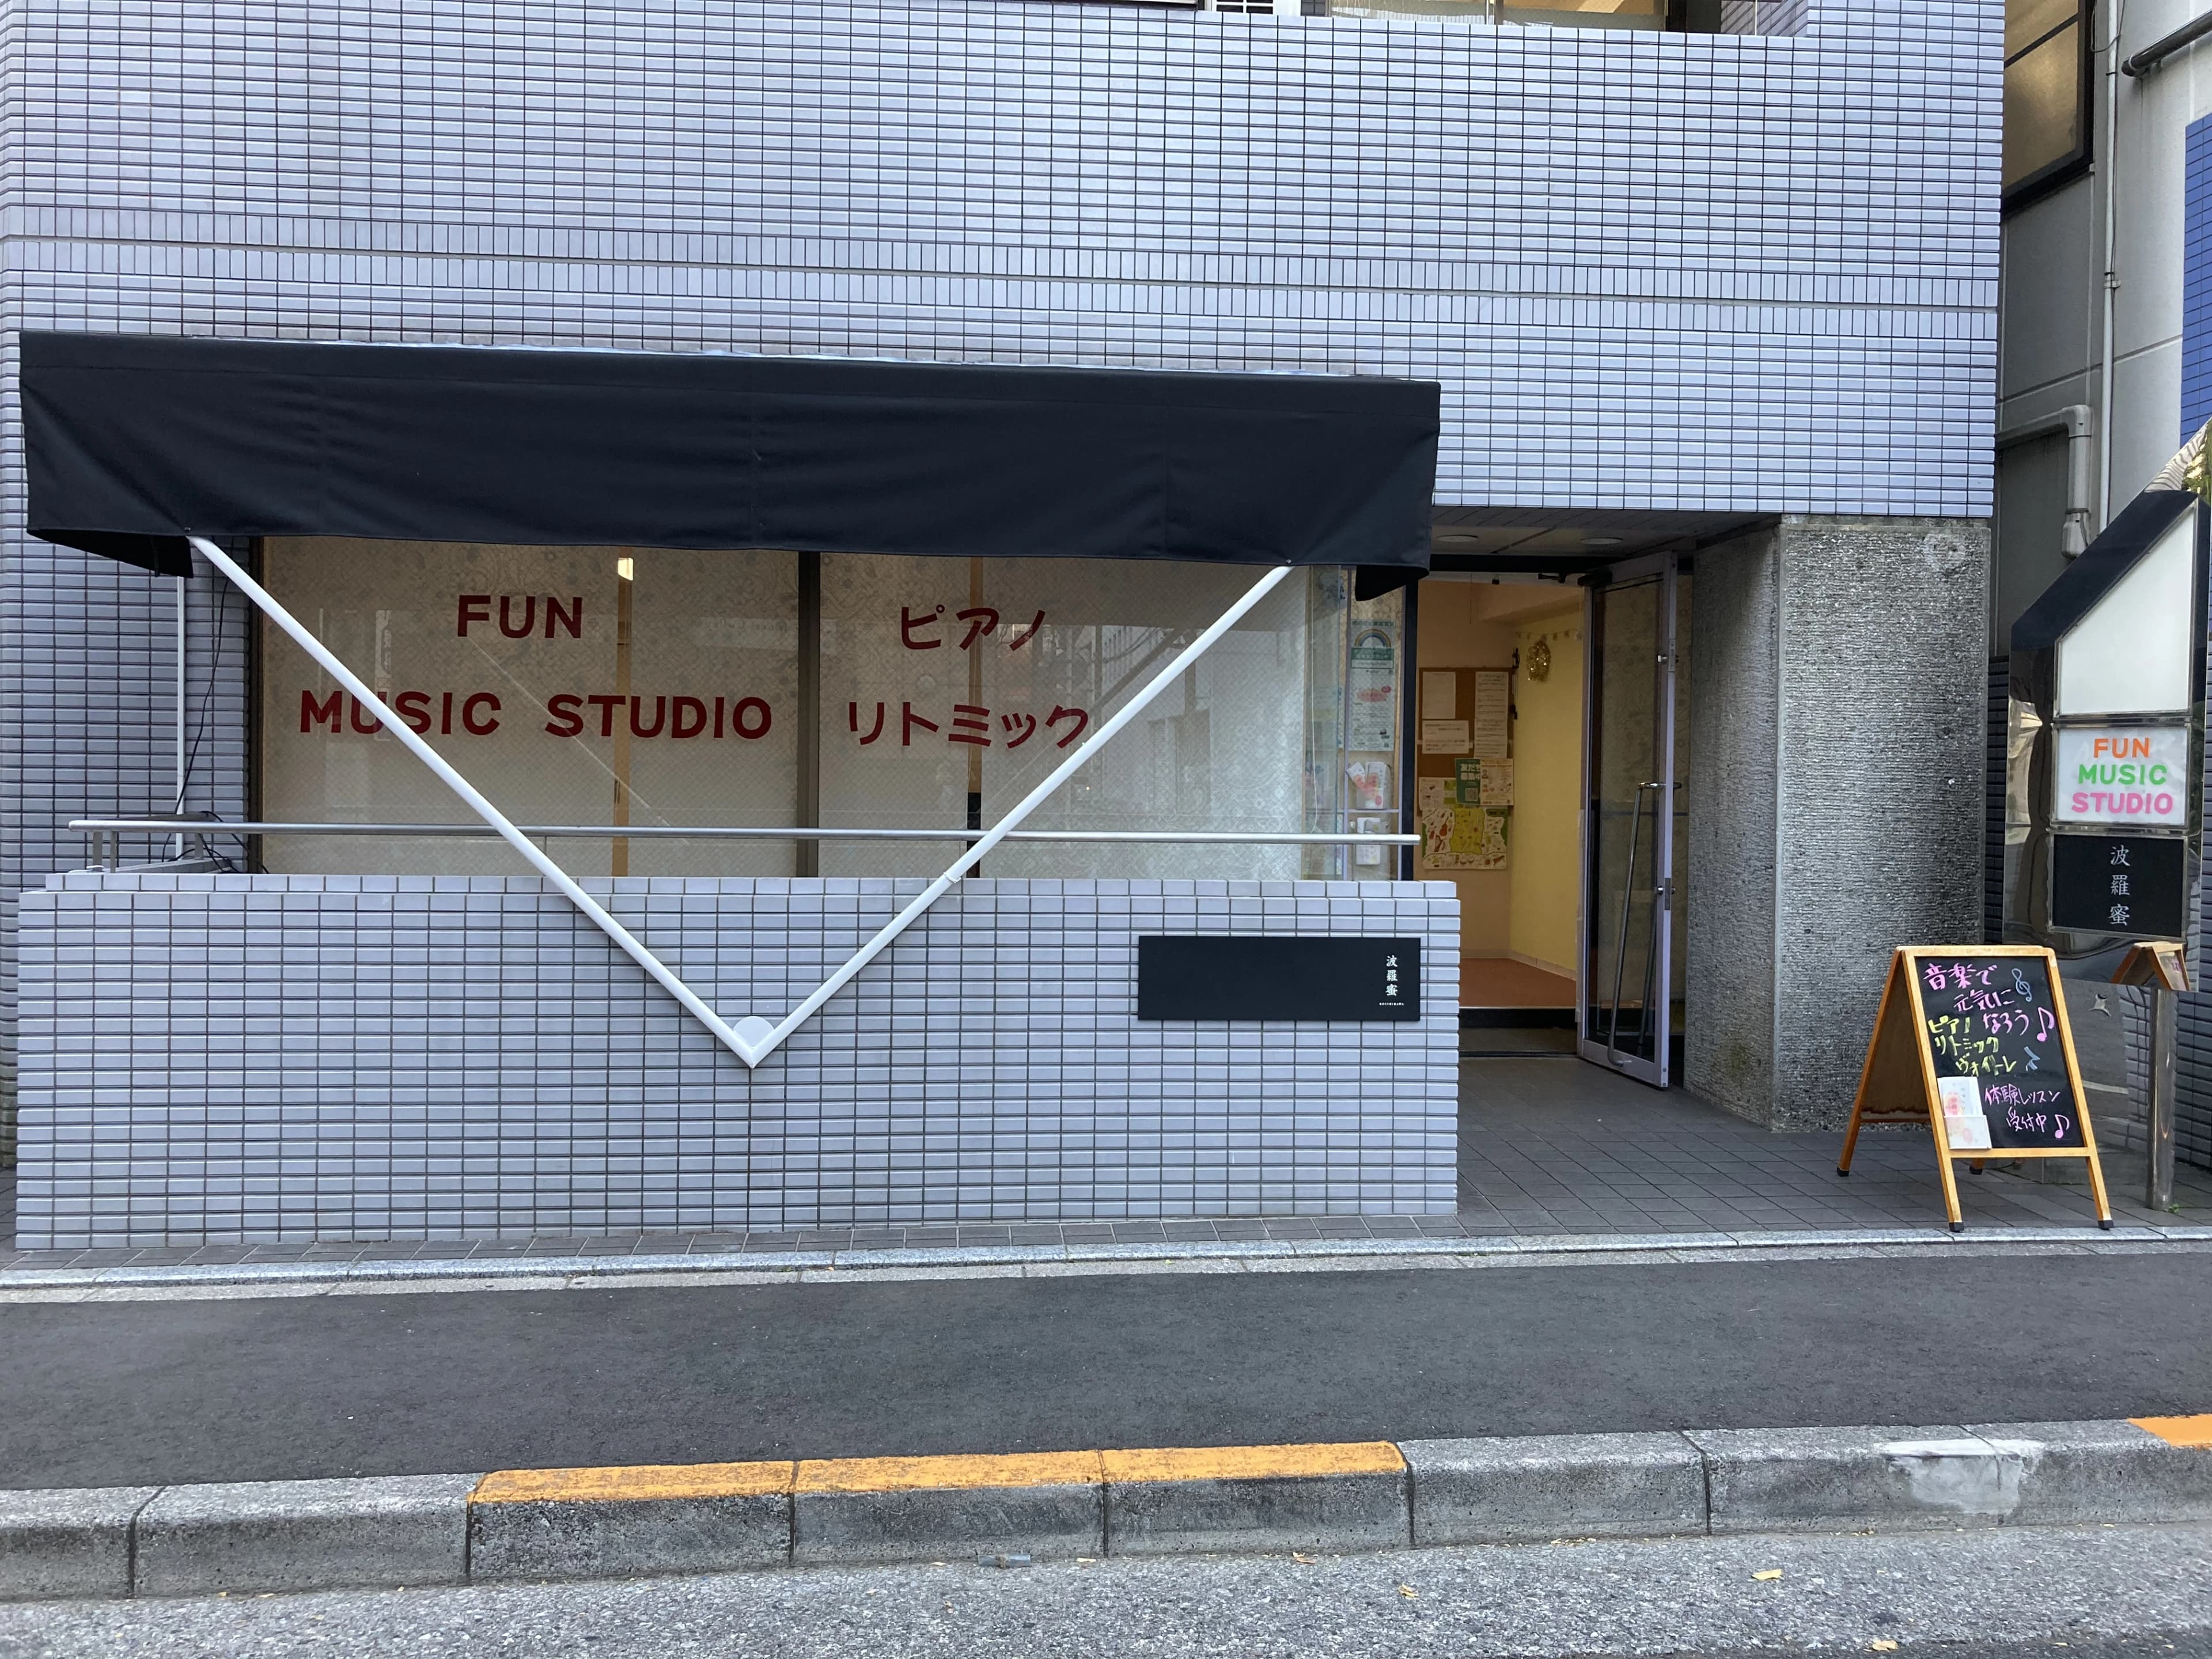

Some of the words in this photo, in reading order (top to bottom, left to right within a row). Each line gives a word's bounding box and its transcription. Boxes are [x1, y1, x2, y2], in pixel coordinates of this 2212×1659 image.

[457, 594, 583, 639] FUN
[902, 604, 1046, 652] ピアノ
[300, 690, 502, 736] MUSIC
[544, 694, 772, 740] STUDIO
[849, 702, 1088, 749] リトミック
[2093, 737, 2150, 758] FUN
[2078, 764, 2167, 785] MUSIC
[2071, 792, 2173, 815] STUDIO
[2108, 844, 2131, 926] 波羅蜜
[1385, 955, 1398, 996] 波羅蜜
[1923, 963, 1998, 990] 音楽で
[1953, 989, 2014, 1012] 元気に
[1928, 1015, 1971, 1034] ピアノ
[1983, 1010, 2029, 1036] なろう
[1934, 1035, 1999, 1056] リトミック
[1985, 1083, 2061, 1106] 体験レッスン
[2006, 1106, 2047, 1132] 受付中
